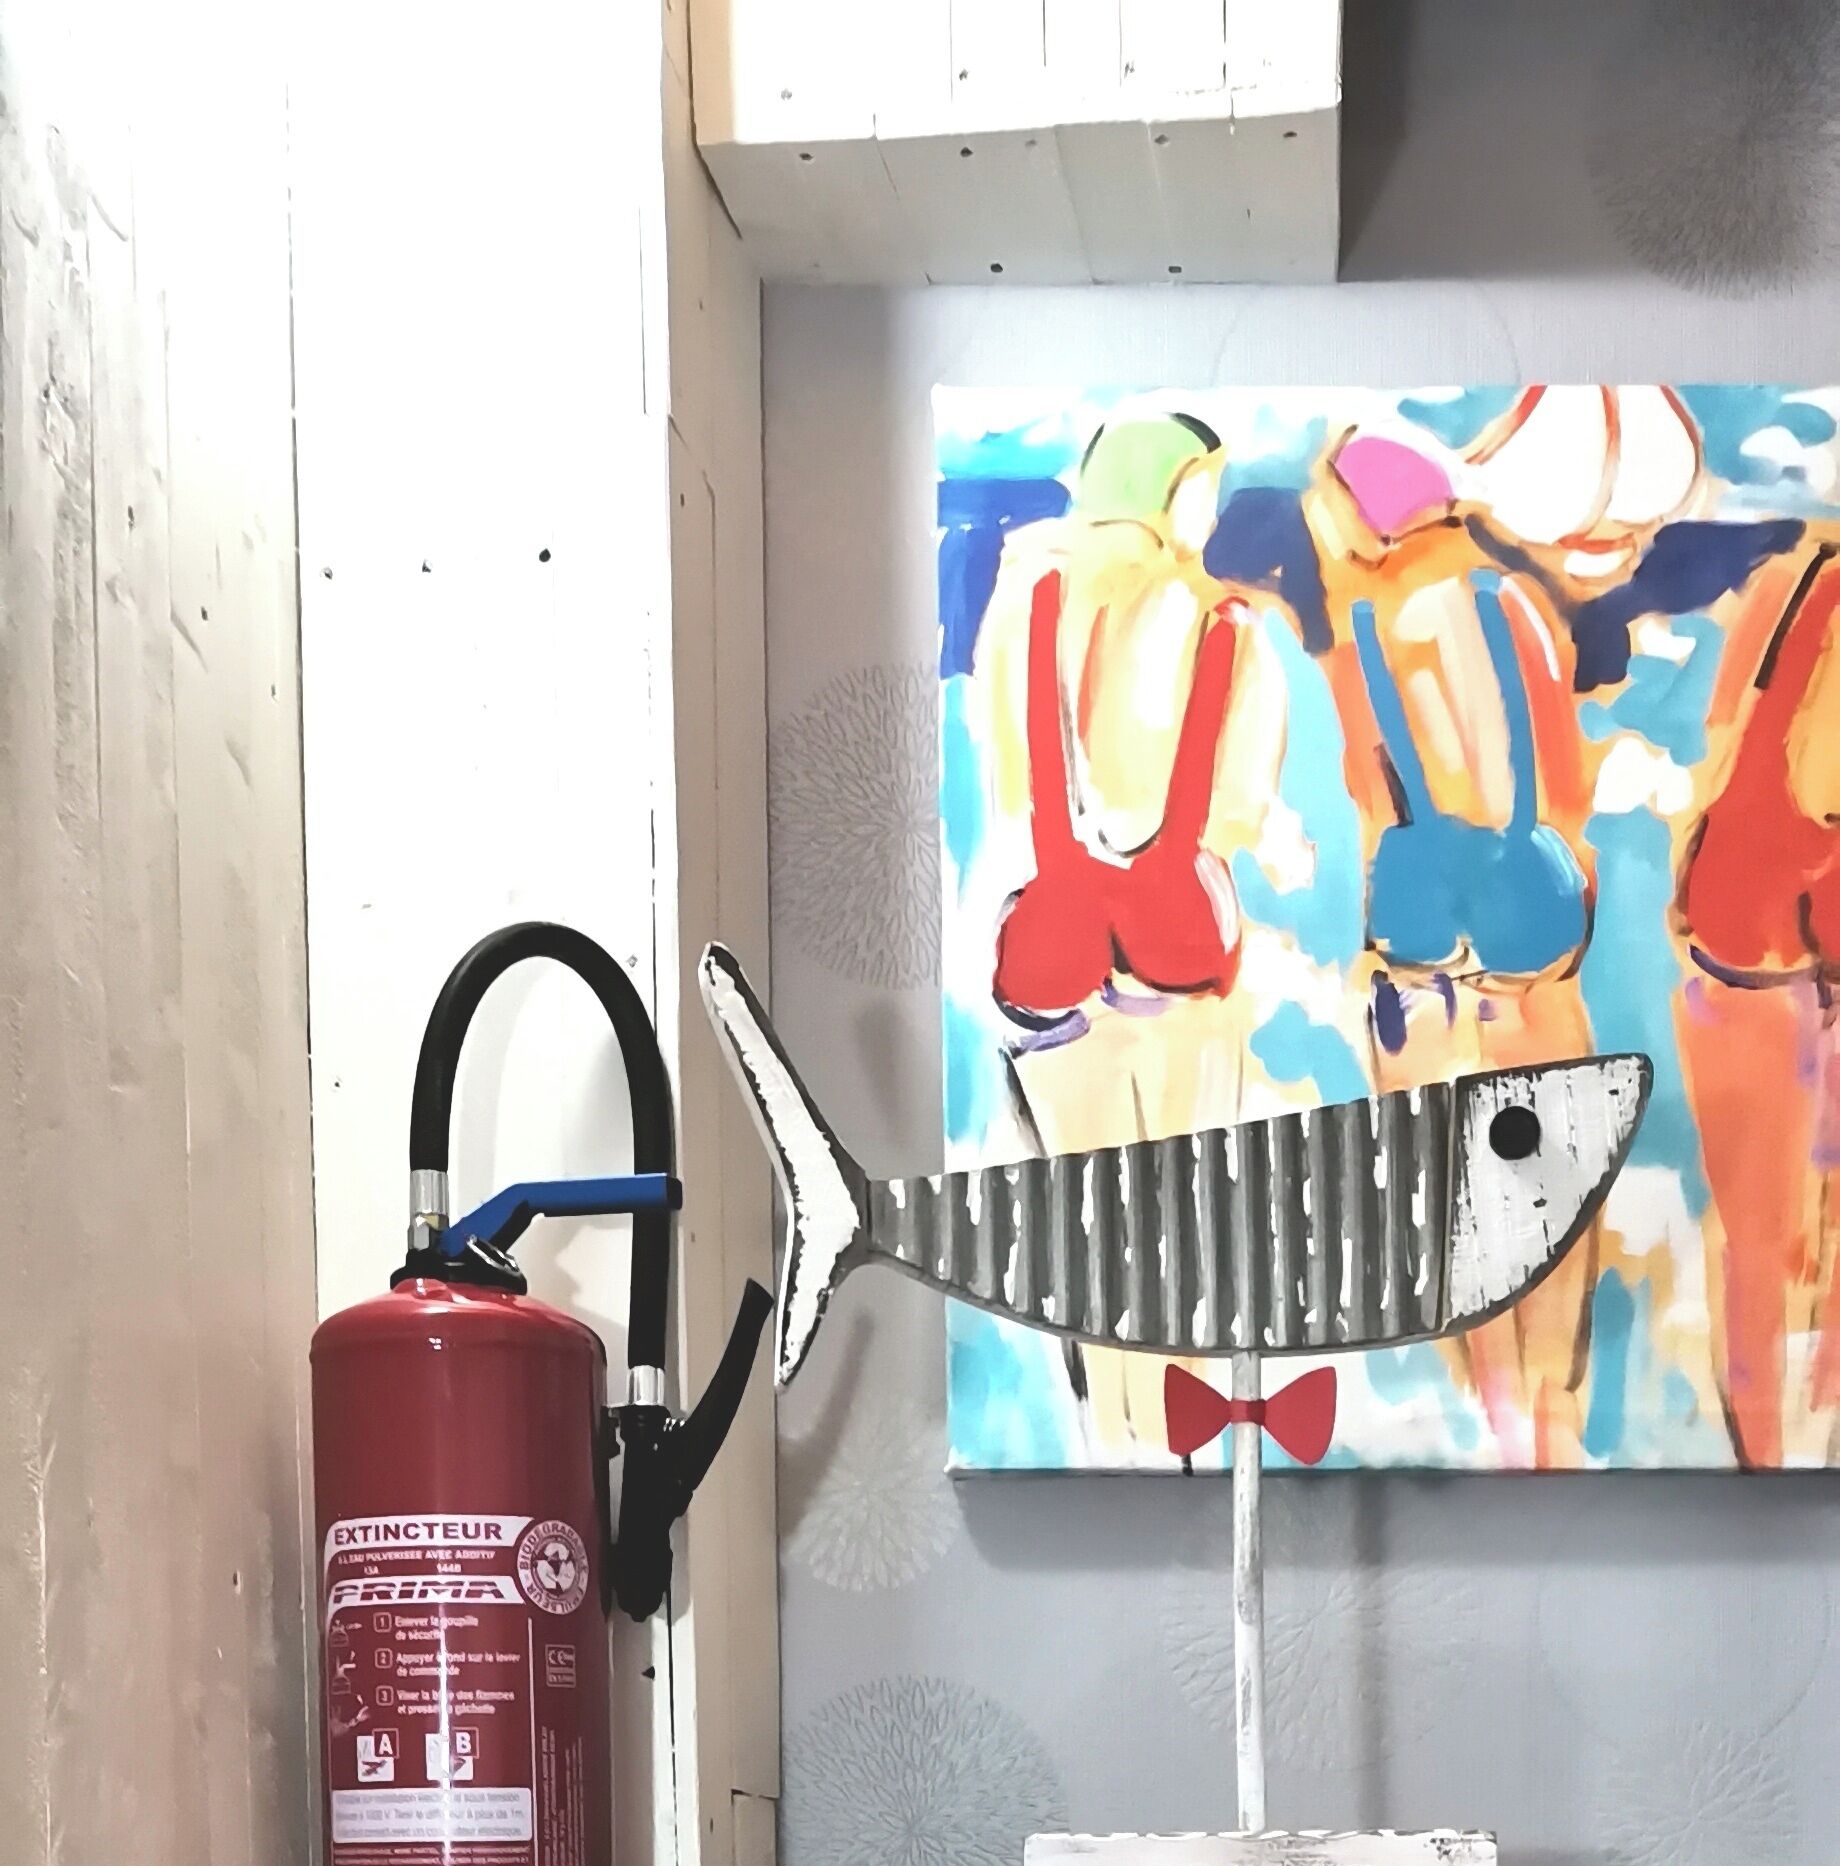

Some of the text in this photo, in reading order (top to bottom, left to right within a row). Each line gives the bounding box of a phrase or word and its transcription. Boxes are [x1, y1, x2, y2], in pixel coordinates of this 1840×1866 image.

[334, 1522, 503, 1545] EXTINCTEUR
[425, 1550, 453, 1560] AVEC
[333, 1580, 505, 1604] PRIMA
[378, 1733, 394, 1755] A
[455, 1732, 472, 1753] B
